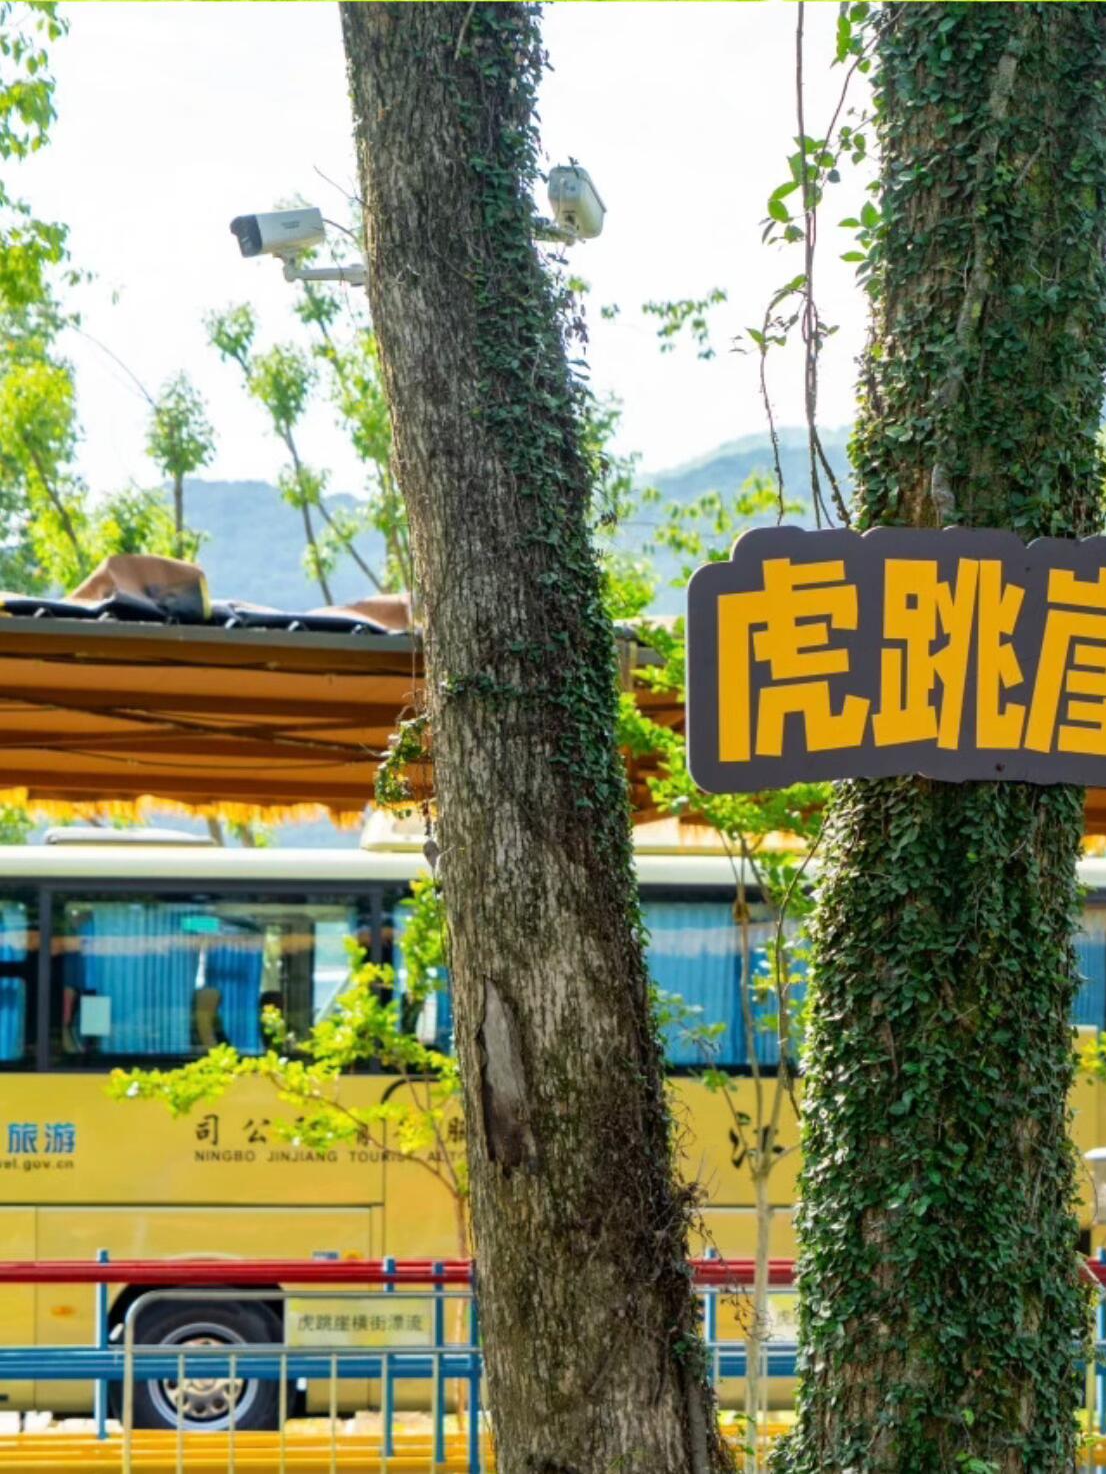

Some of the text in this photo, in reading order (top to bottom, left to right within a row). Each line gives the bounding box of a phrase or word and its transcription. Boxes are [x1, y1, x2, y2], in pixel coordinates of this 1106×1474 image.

[8, 1123, 76, 1154] 旅游
[194, 1150, 256, 1163] NINGBO
[266, 1150, 338, 1164] JINJIANG
[349, 1151, 411, 1164] TOURIS
